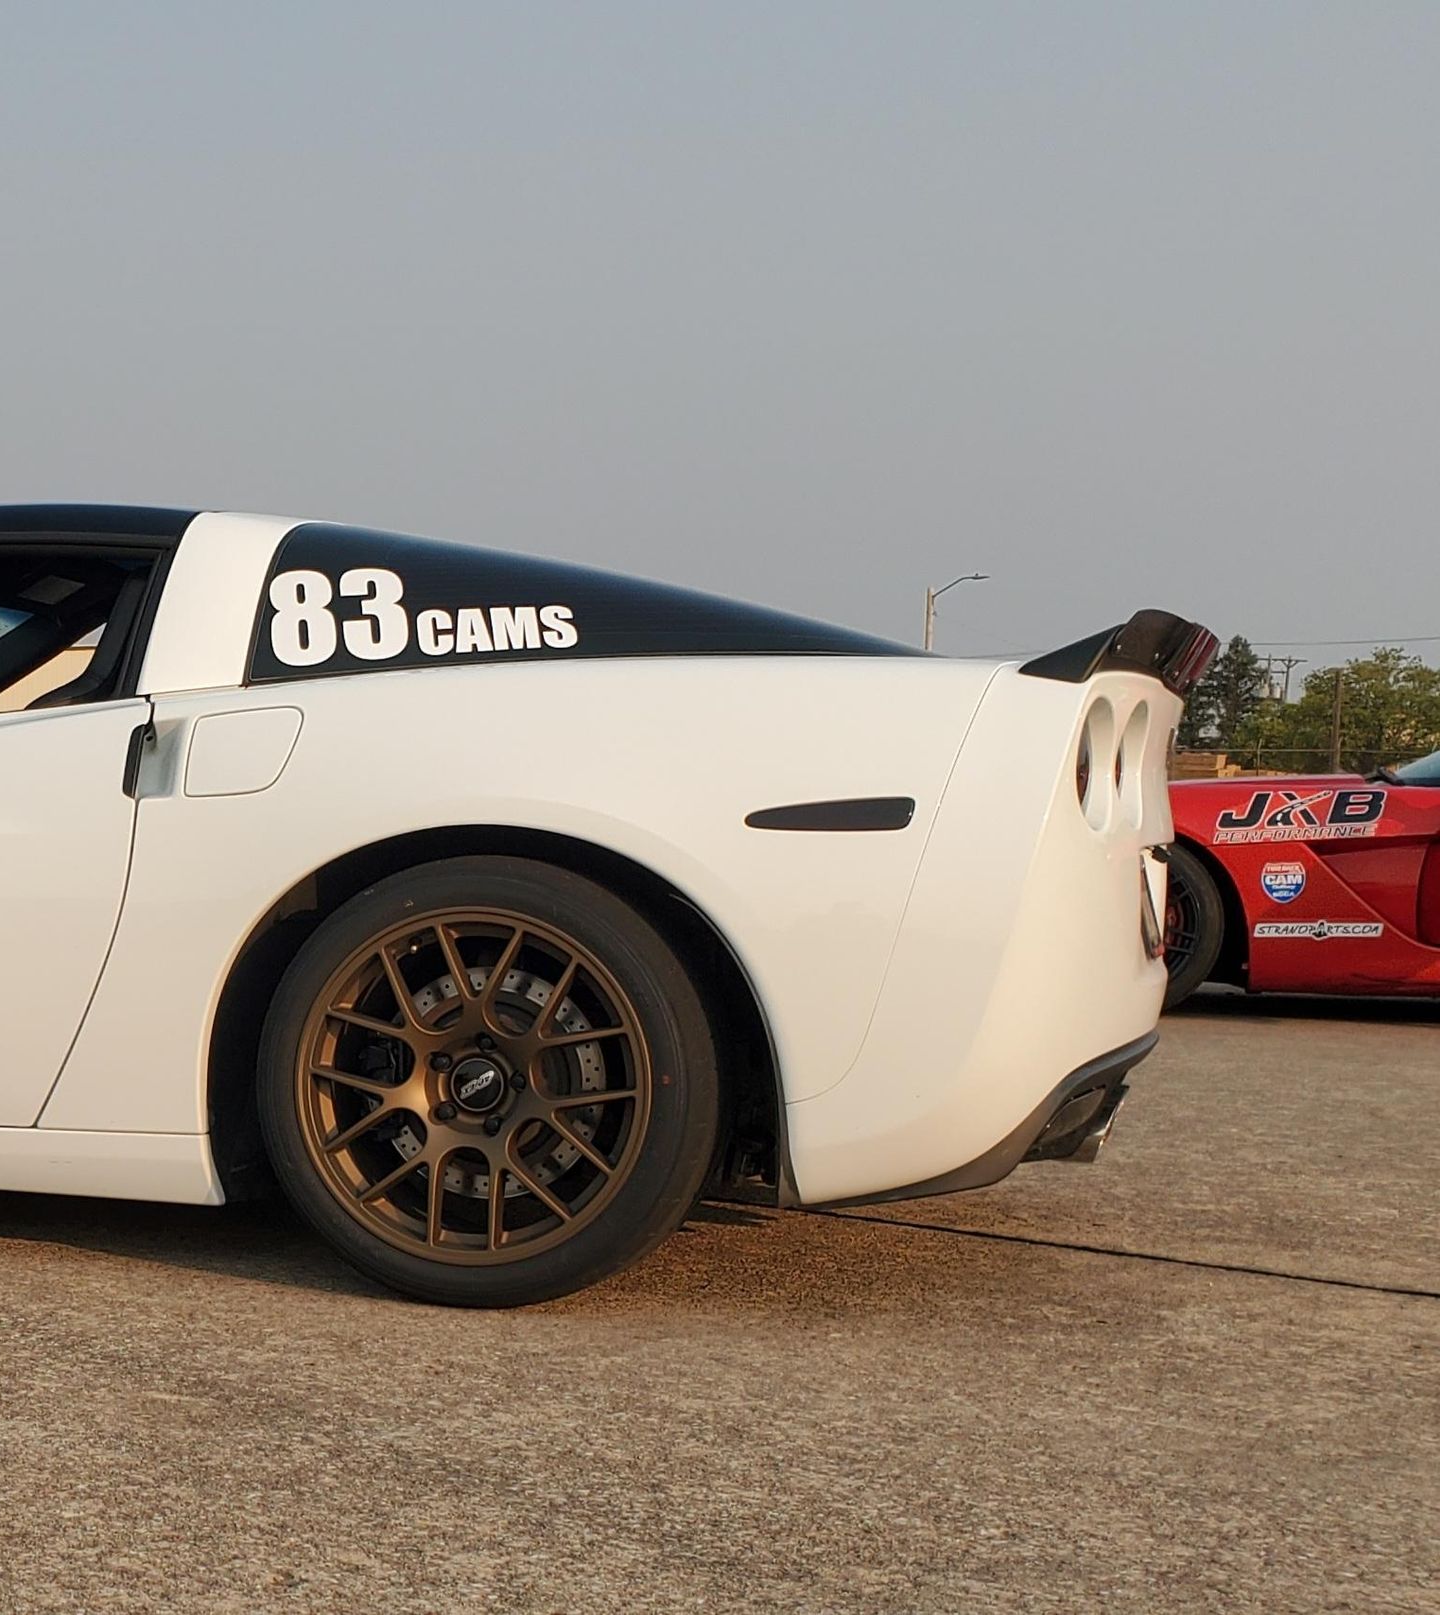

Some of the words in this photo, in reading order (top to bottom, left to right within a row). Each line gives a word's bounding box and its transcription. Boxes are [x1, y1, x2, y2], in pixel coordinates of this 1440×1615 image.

[269, 568, 408, 666] 83
[416, 605, 578, 656] CAMS
[1216, 790, 1387, 829] JXB
[1213, 824, 1378, 843] PERFORMANCE
[1264, 874, 1303, 885] CAM
